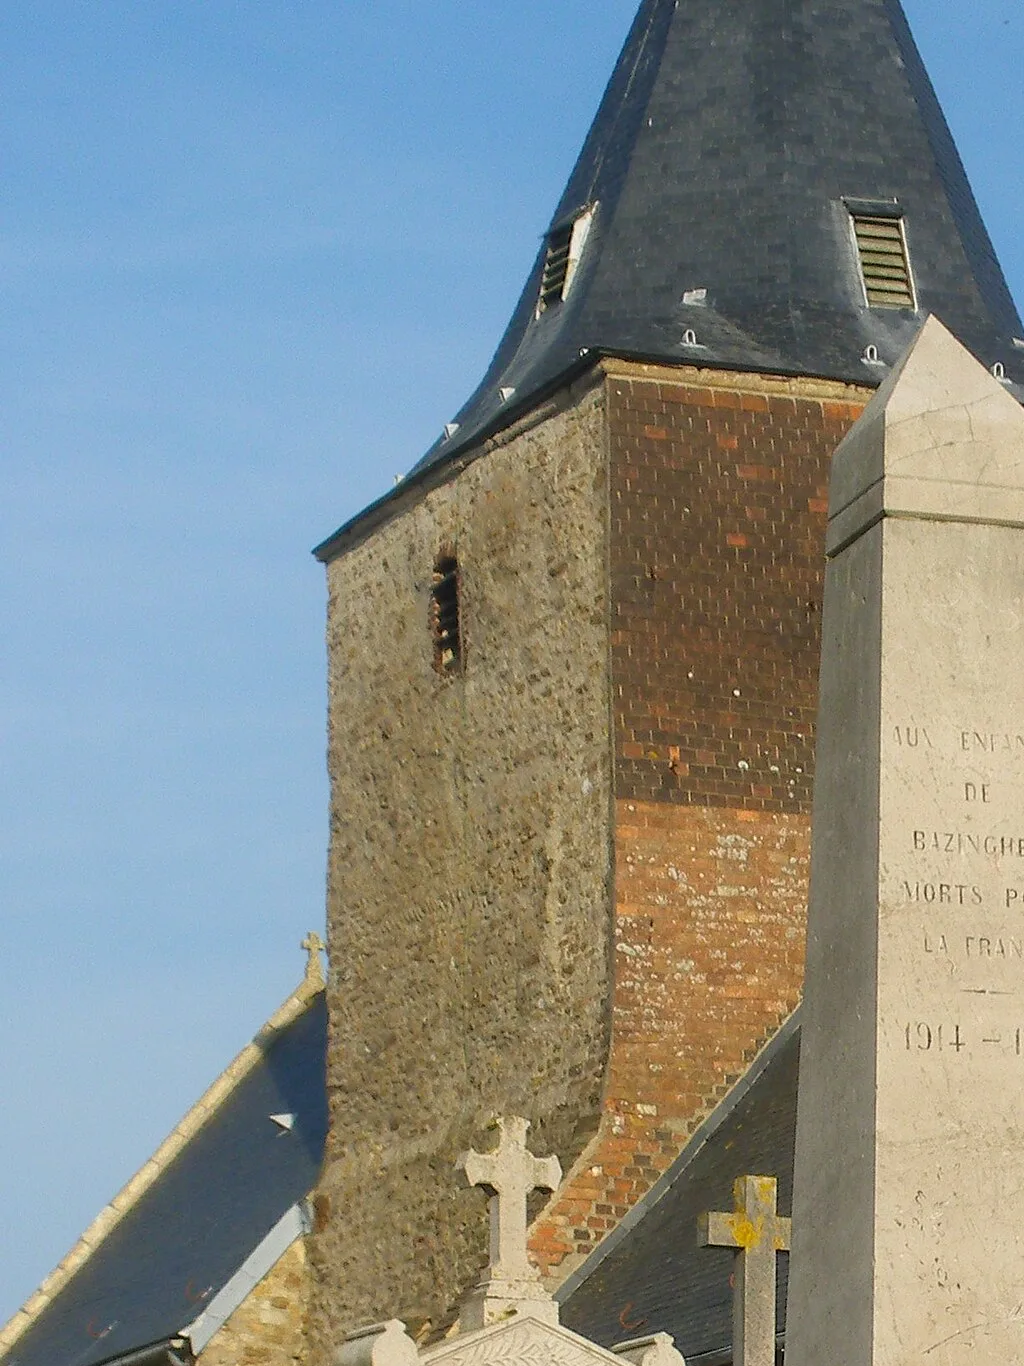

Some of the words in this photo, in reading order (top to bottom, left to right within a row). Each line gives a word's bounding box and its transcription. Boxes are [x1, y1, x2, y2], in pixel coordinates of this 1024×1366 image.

[893, 726, 934, 749] AUX
[964, 783, 991, 804] DE
[903, 882, 983, 905] MORTS
[924, 935, 947, 954] LA
[905, 1022, 966, 1052] 1914
